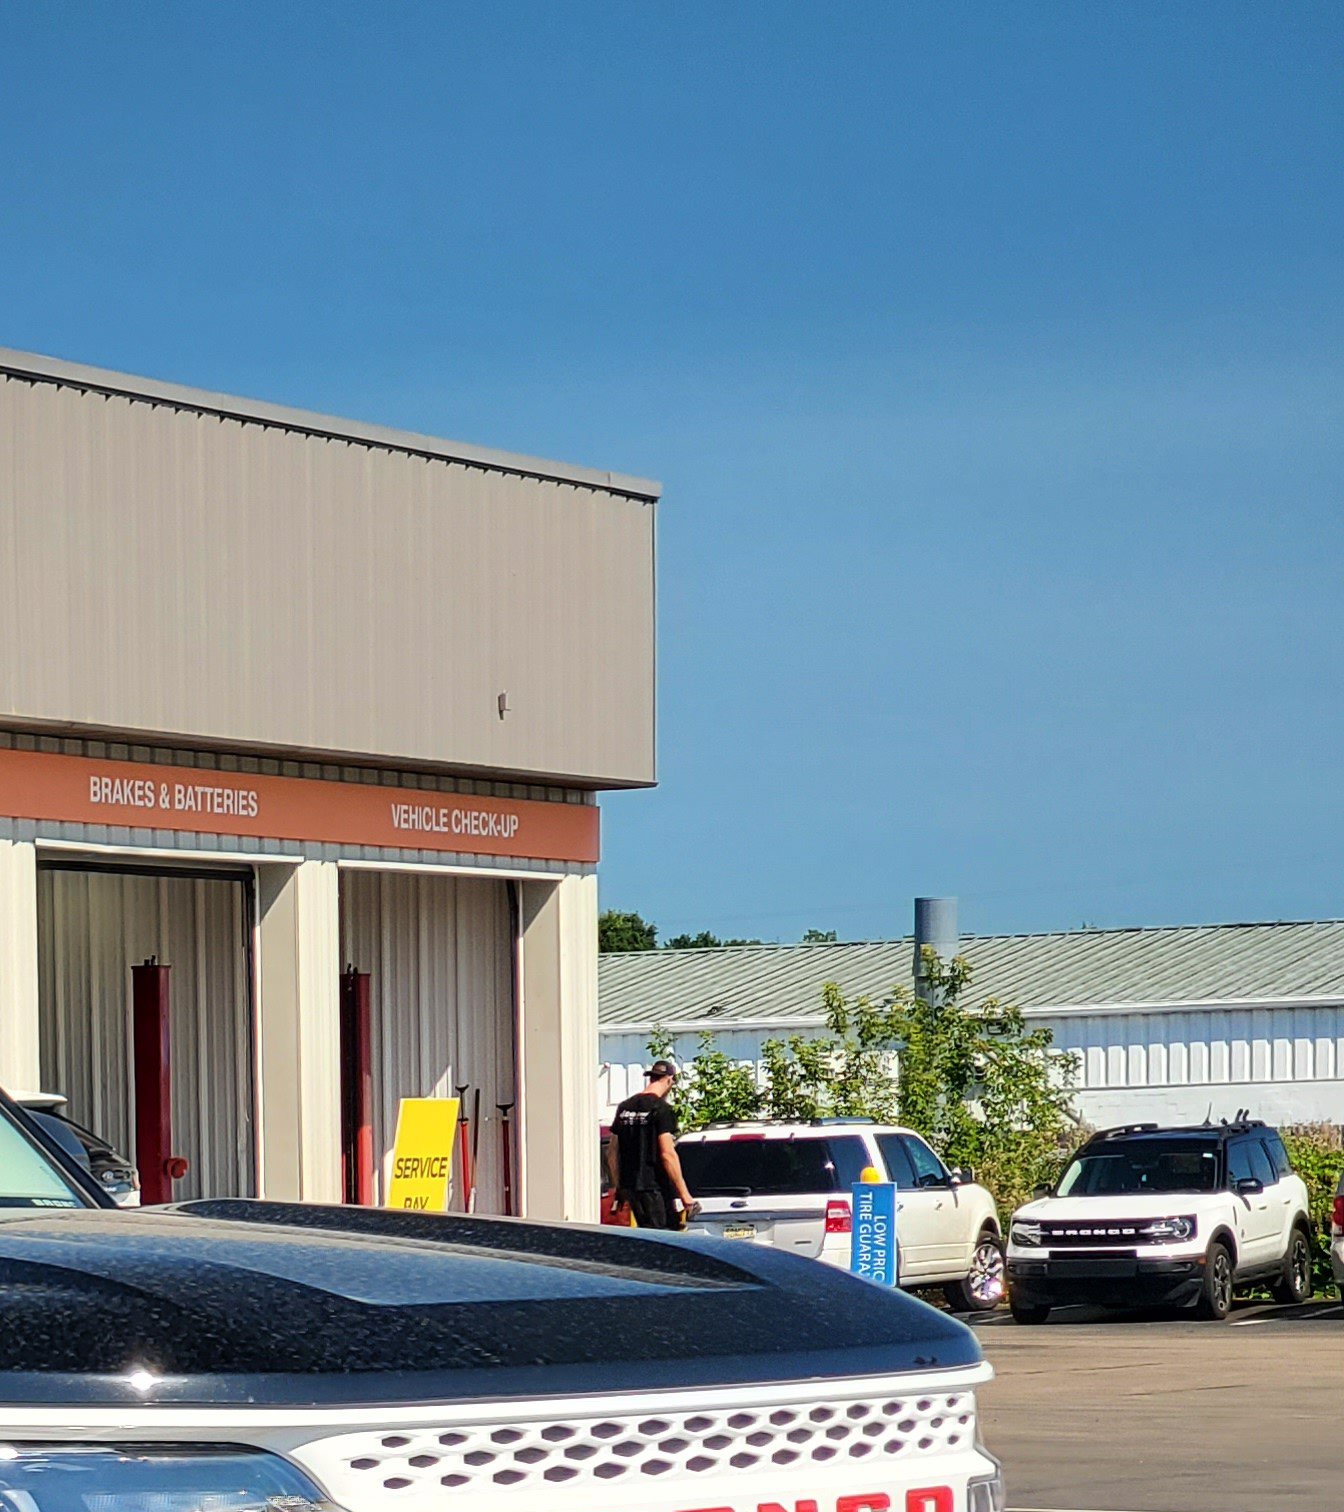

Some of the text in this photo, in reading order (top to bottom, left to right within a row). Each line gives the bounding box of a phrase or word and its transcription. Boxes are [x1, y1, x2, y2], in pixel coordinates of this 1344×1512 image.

[90, 776, 258, 817] BRAKES & BATTERIES
[391, 803, 518, 838] VEHICLE CHECK-UP
[395, 1157, 448, 1179] SERVICE
[858, 1191, 872, 1275] TIRE GUARA
[873, 1216, 887, 1282] LOW PRIC
